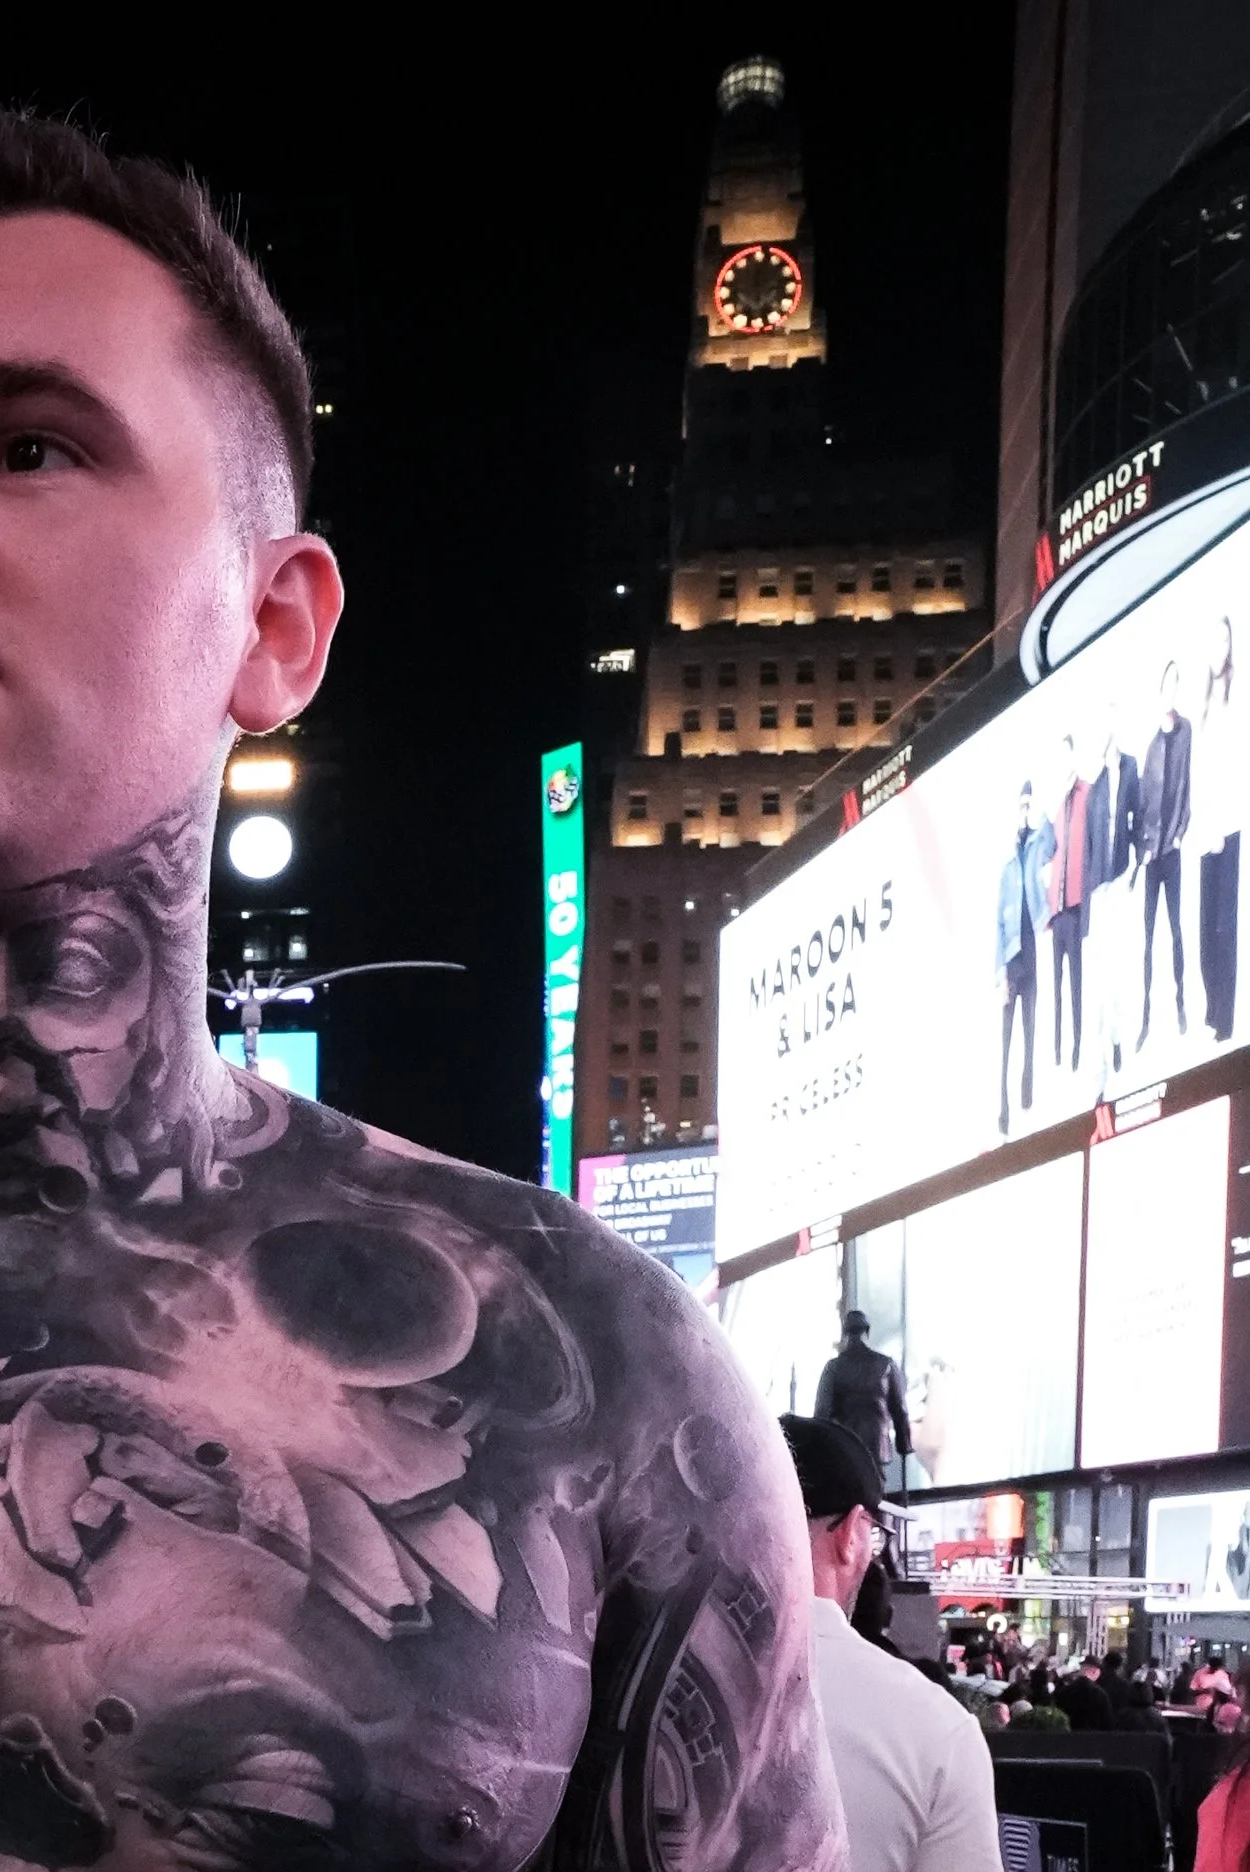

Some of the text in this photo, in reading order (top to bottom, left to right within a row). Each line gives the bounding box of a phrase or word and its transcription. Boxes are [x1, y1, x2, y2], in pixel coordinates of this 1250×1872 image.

[1058, 483, 1149, 566] MARQUIS
[1059, 441, 1165, 535] MARRIOTT
[750, 879, 893, 1012] MAROON 5
[777, 971, 858, 1059] & LISA
[593, 1184, 618, 1203] OF
[618, 1183, 634, 1200] A
[594, 1165, 630, 1186] THE
